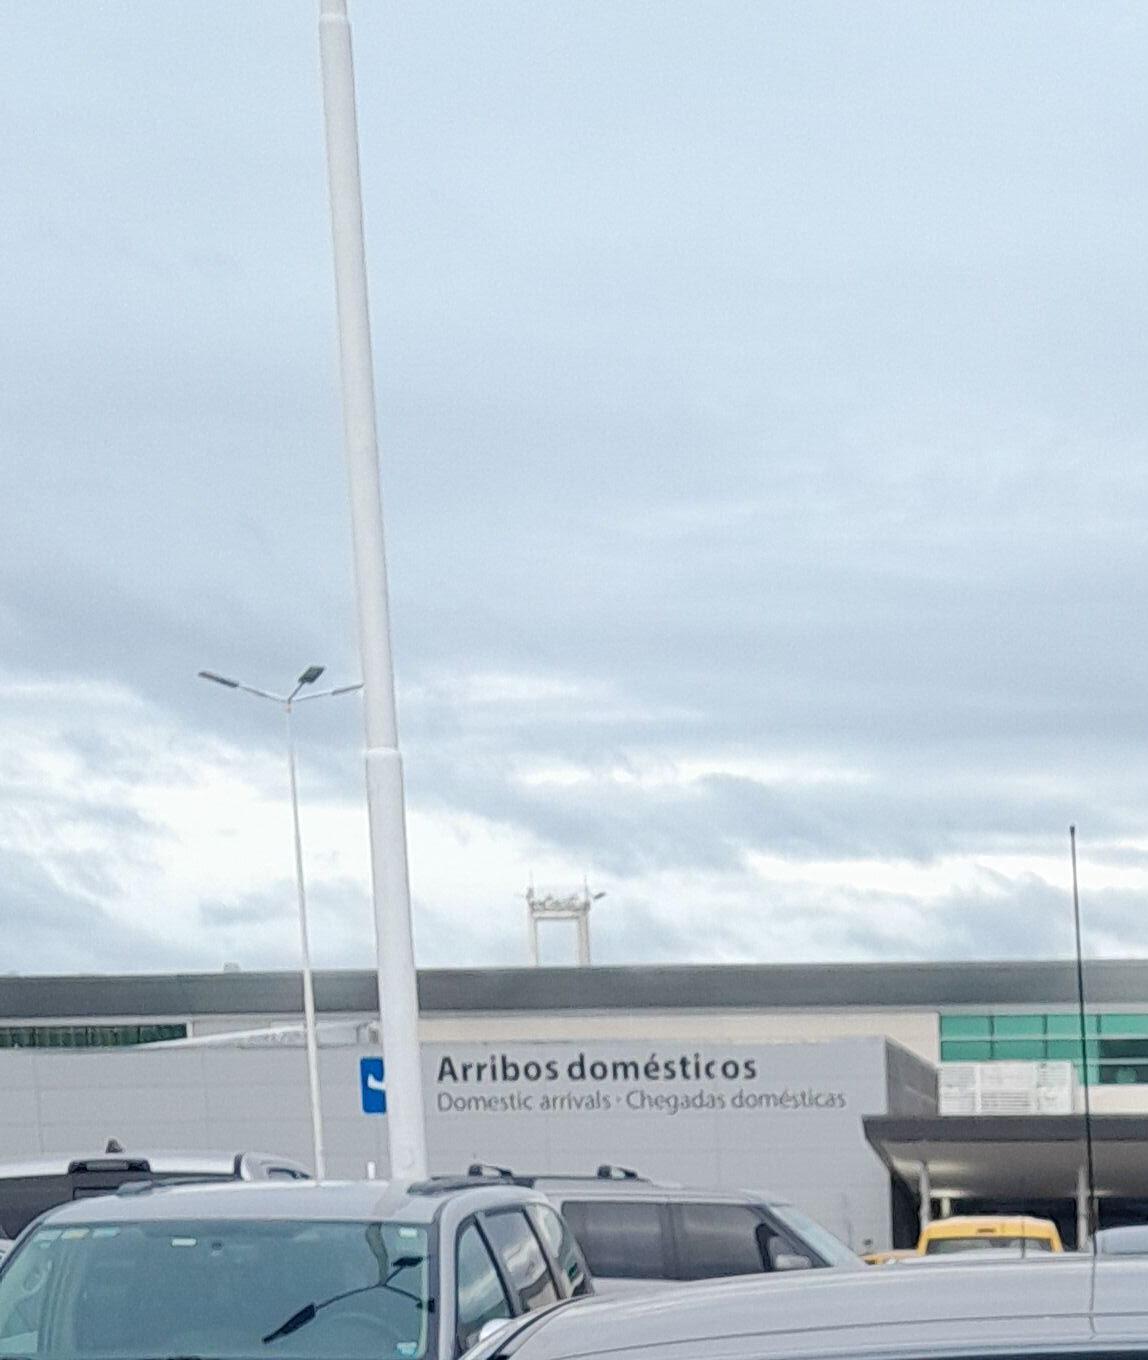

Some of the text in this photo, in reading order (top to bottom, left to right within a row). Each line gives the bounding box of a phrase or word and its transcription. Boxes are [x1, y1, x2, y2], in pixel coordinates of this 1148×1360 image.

[437, 1053, 757, 1081] Arribos domésticos
[437, 1087, 848, 1116] Domestic arrivals Chegadas domésticas
